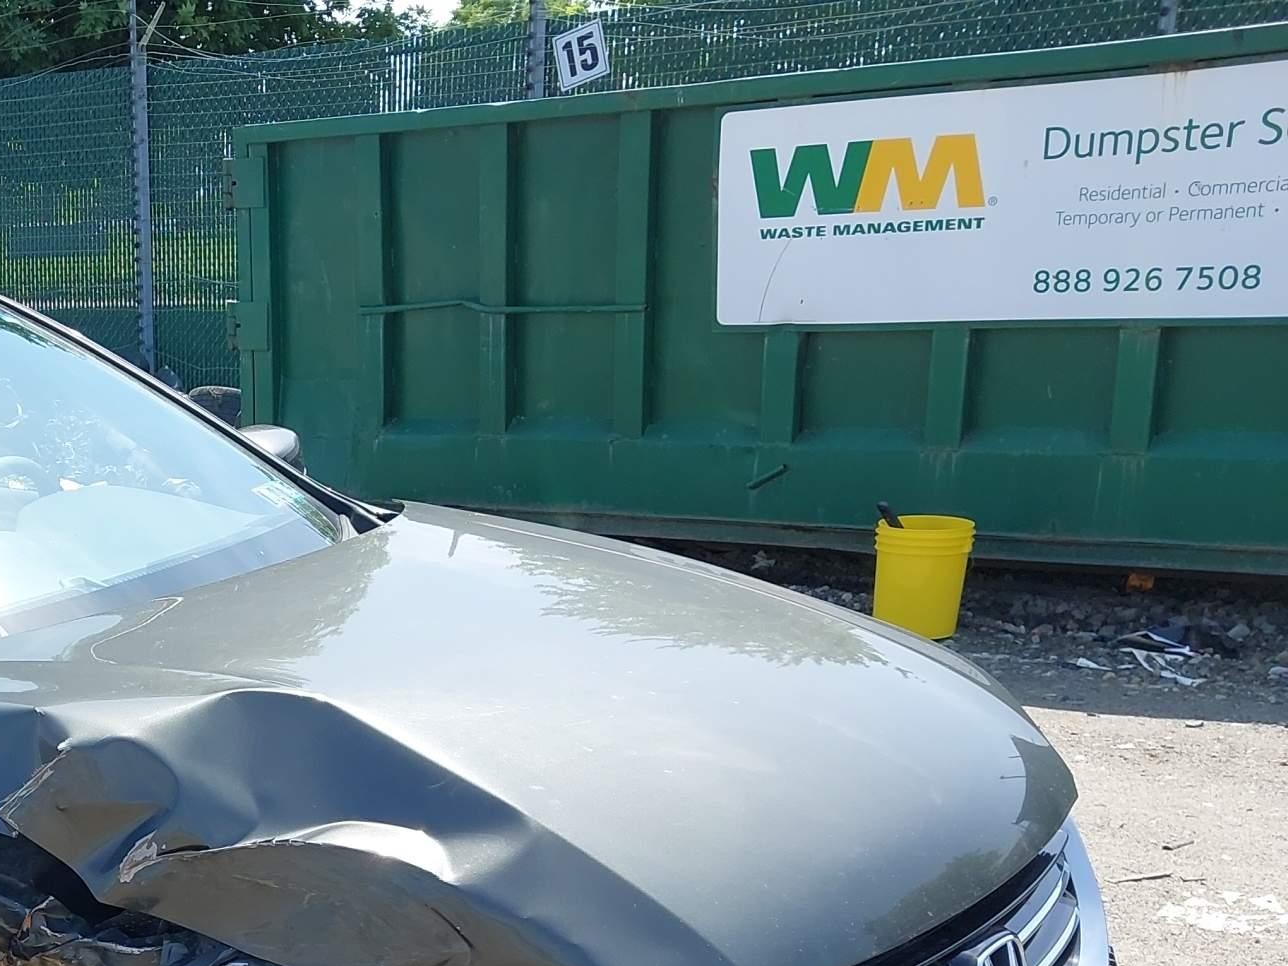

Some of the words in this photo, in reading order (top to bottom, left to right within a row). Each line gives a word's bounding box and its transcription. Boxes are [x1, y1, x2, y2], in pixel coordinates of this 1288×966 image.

[561, 30, 599, 78] 15
[1043, 118, 1246, 165] Dumpster
[1258, 106, 1288, 146] S
[750, 134, 985, 219] WM
[1078, 182, 1167, 202] Residential
[759, 225, 827, 240] WASTE
[832, 217, 986, 237] MANAGEMENT
[1055, 210, 1142, 229] Temporary
[1145, 209, 1165, 223] or
[1169, 202, 1265, 222] Permanent
[1032, 269, 1092, 294] 888
[1103, 267, 1164, 293] 926
[1175, 264, 1262, 291] 7508
